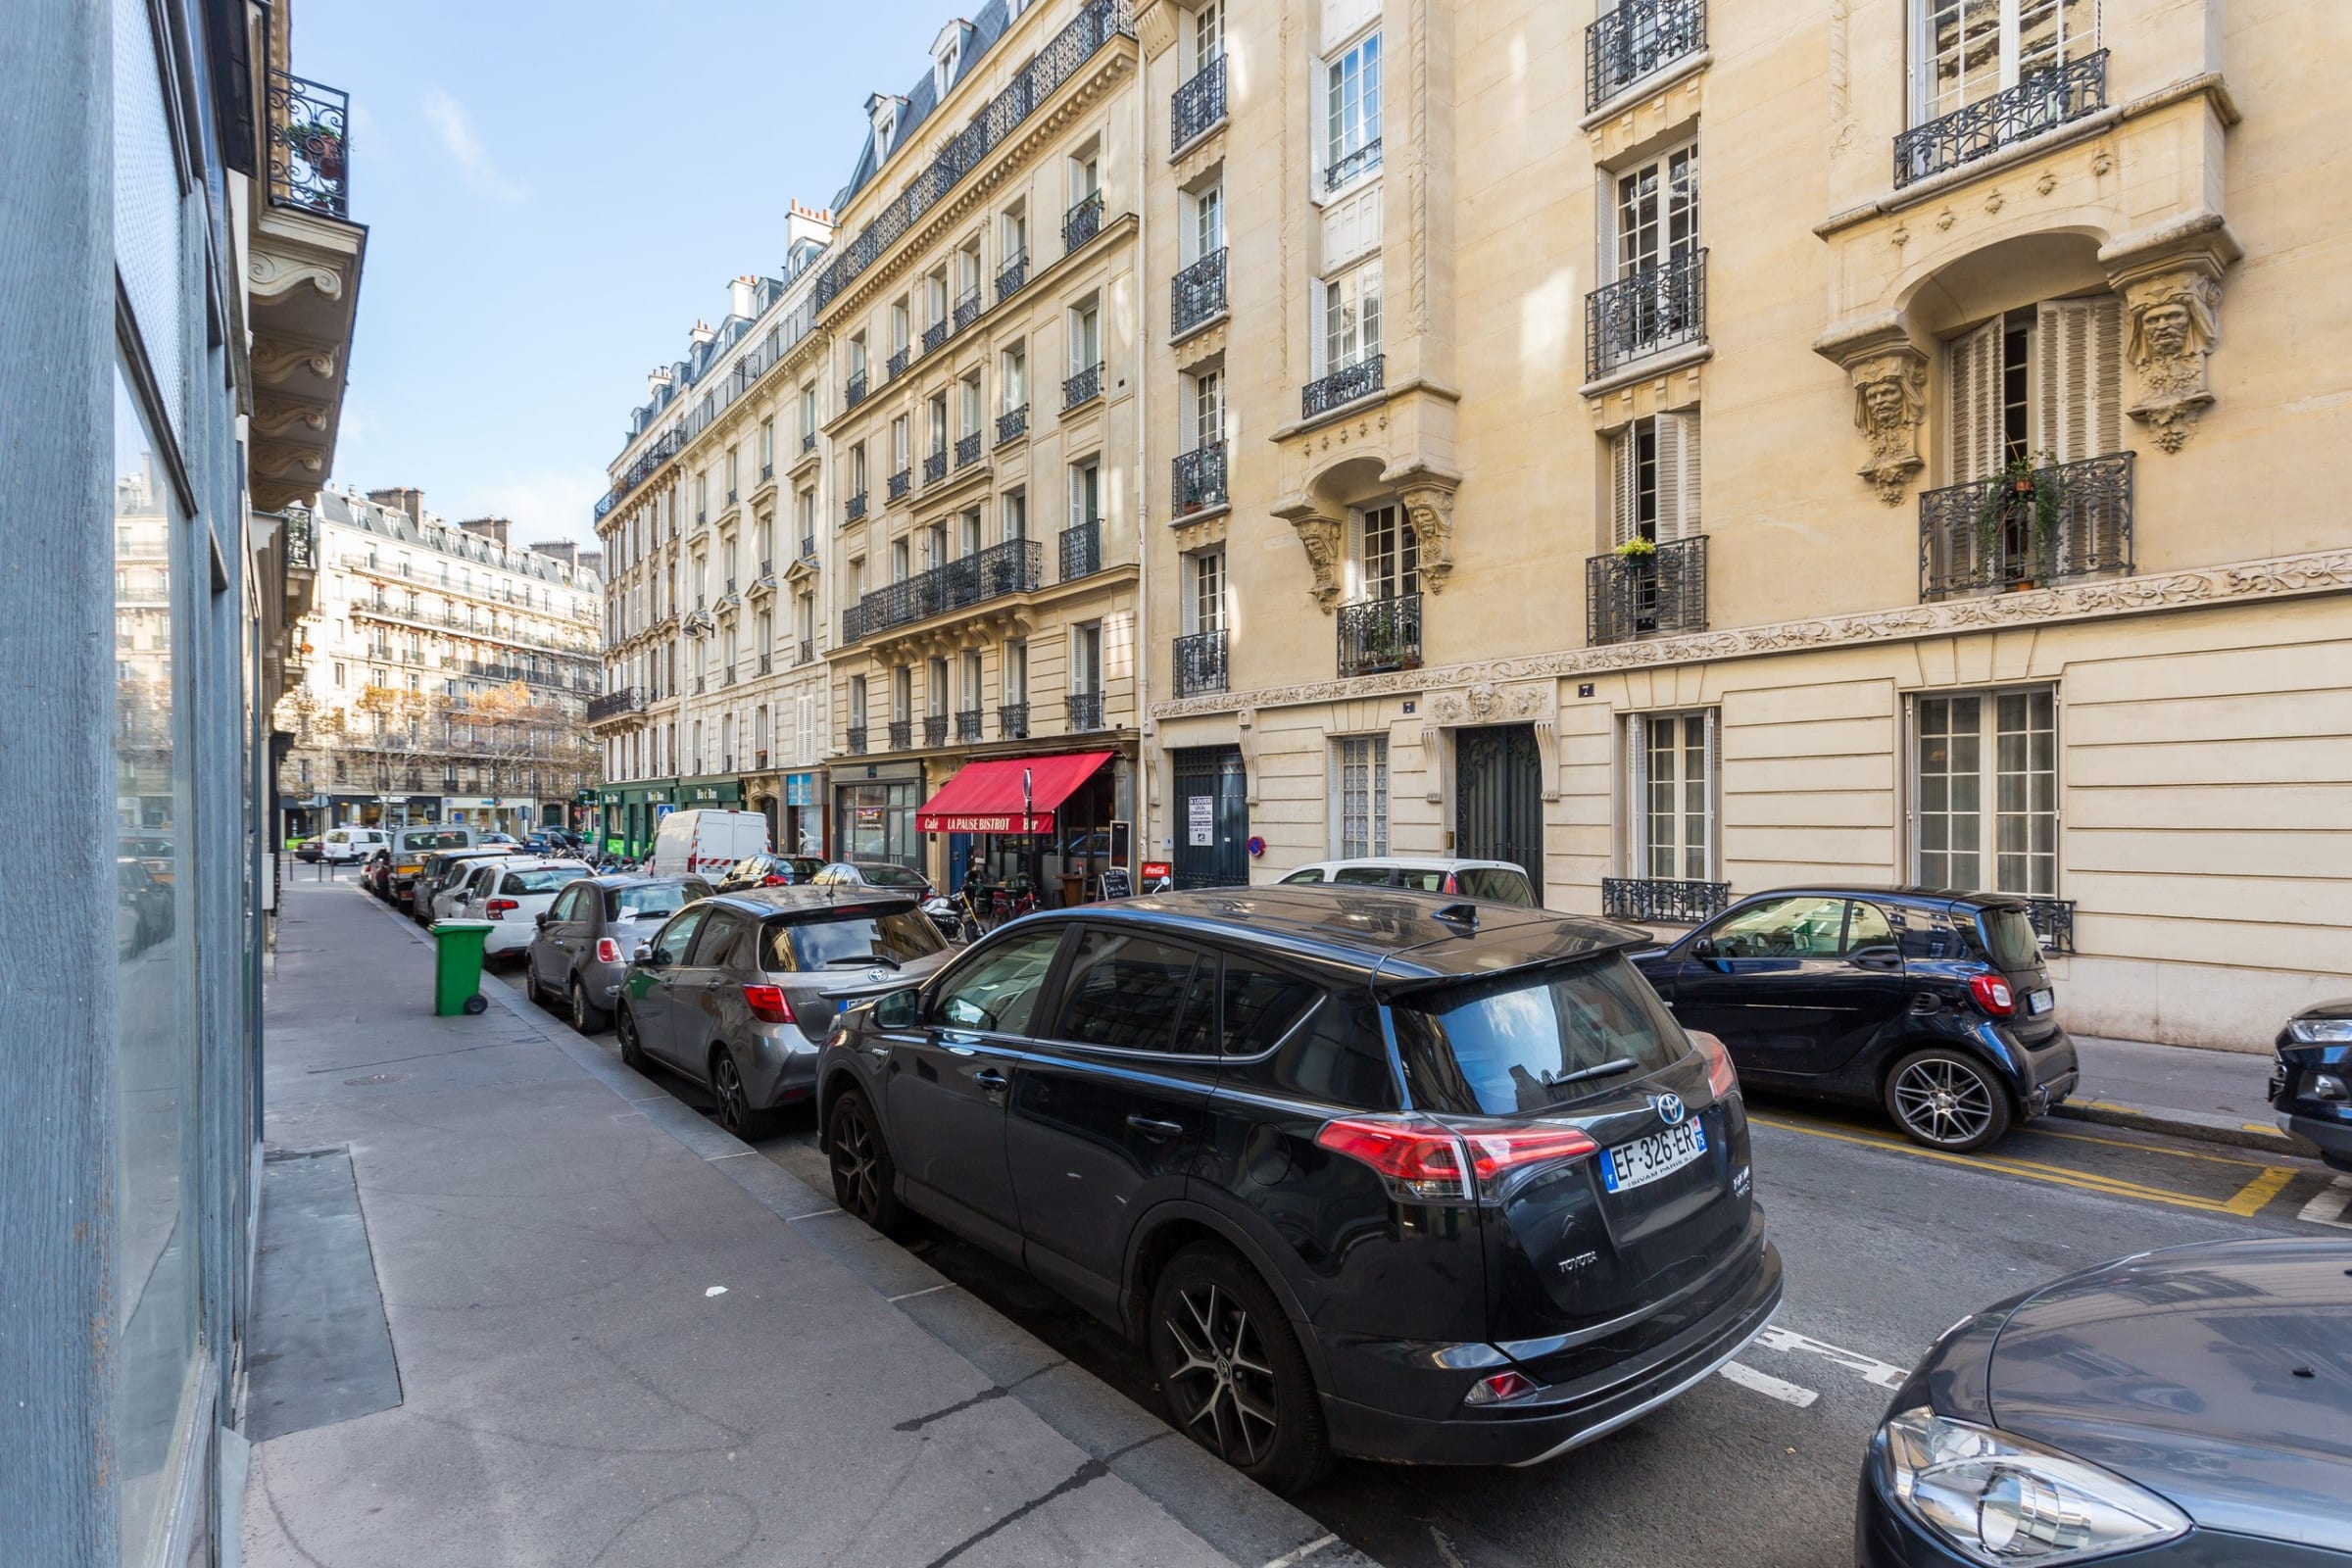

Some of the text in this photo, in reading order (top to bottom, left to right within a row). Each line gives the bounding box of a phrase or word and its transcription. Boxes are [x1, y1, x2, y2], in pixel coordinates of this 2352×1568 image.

[924, 817, 939, 830] Café
[947, 817, 1011, 831] LA PAUSE BISTROT
[1695, 1133, 1705, 1148] 75
[1558, 1250, 1598, 1273] TOYOTA
